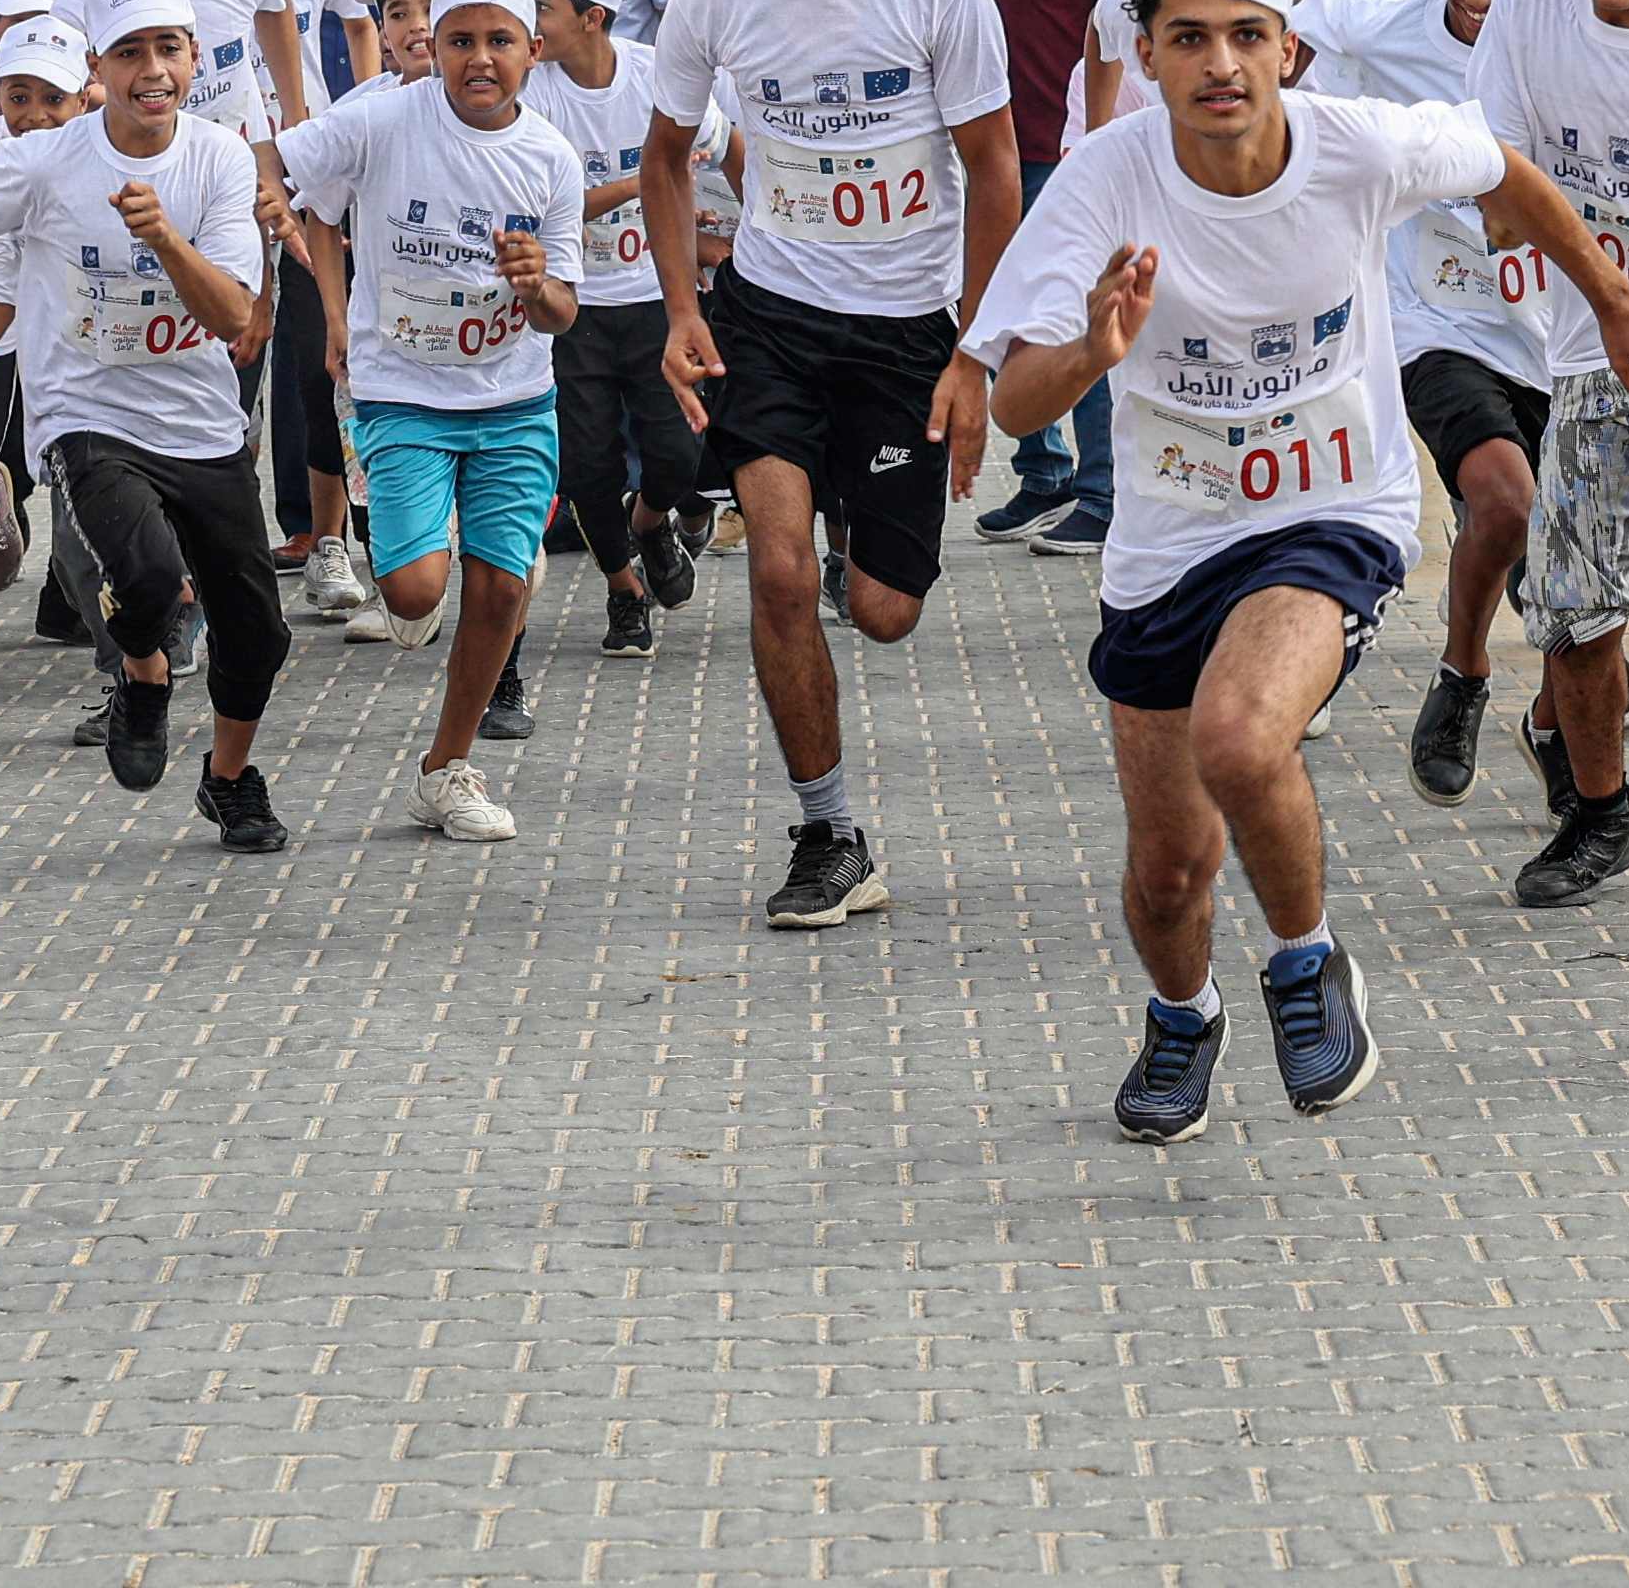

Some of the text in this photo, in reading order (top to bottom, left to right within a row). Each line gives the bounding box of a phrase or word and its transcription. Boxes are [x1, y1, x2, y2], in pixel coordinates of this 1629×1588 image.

[811, 108, 891, 134] ماراثون
[832, 168, 929, 228] 012
[392, 235, 439, 258] الأمل
[1499, 247, 1547, 304] 01
[146, 314, 216, 355] 02
[1168, 371, 1233, 397] الأمل
[1242, 357, 1328, 401] ماثون
[1240, 426, 1355, 503] 011
